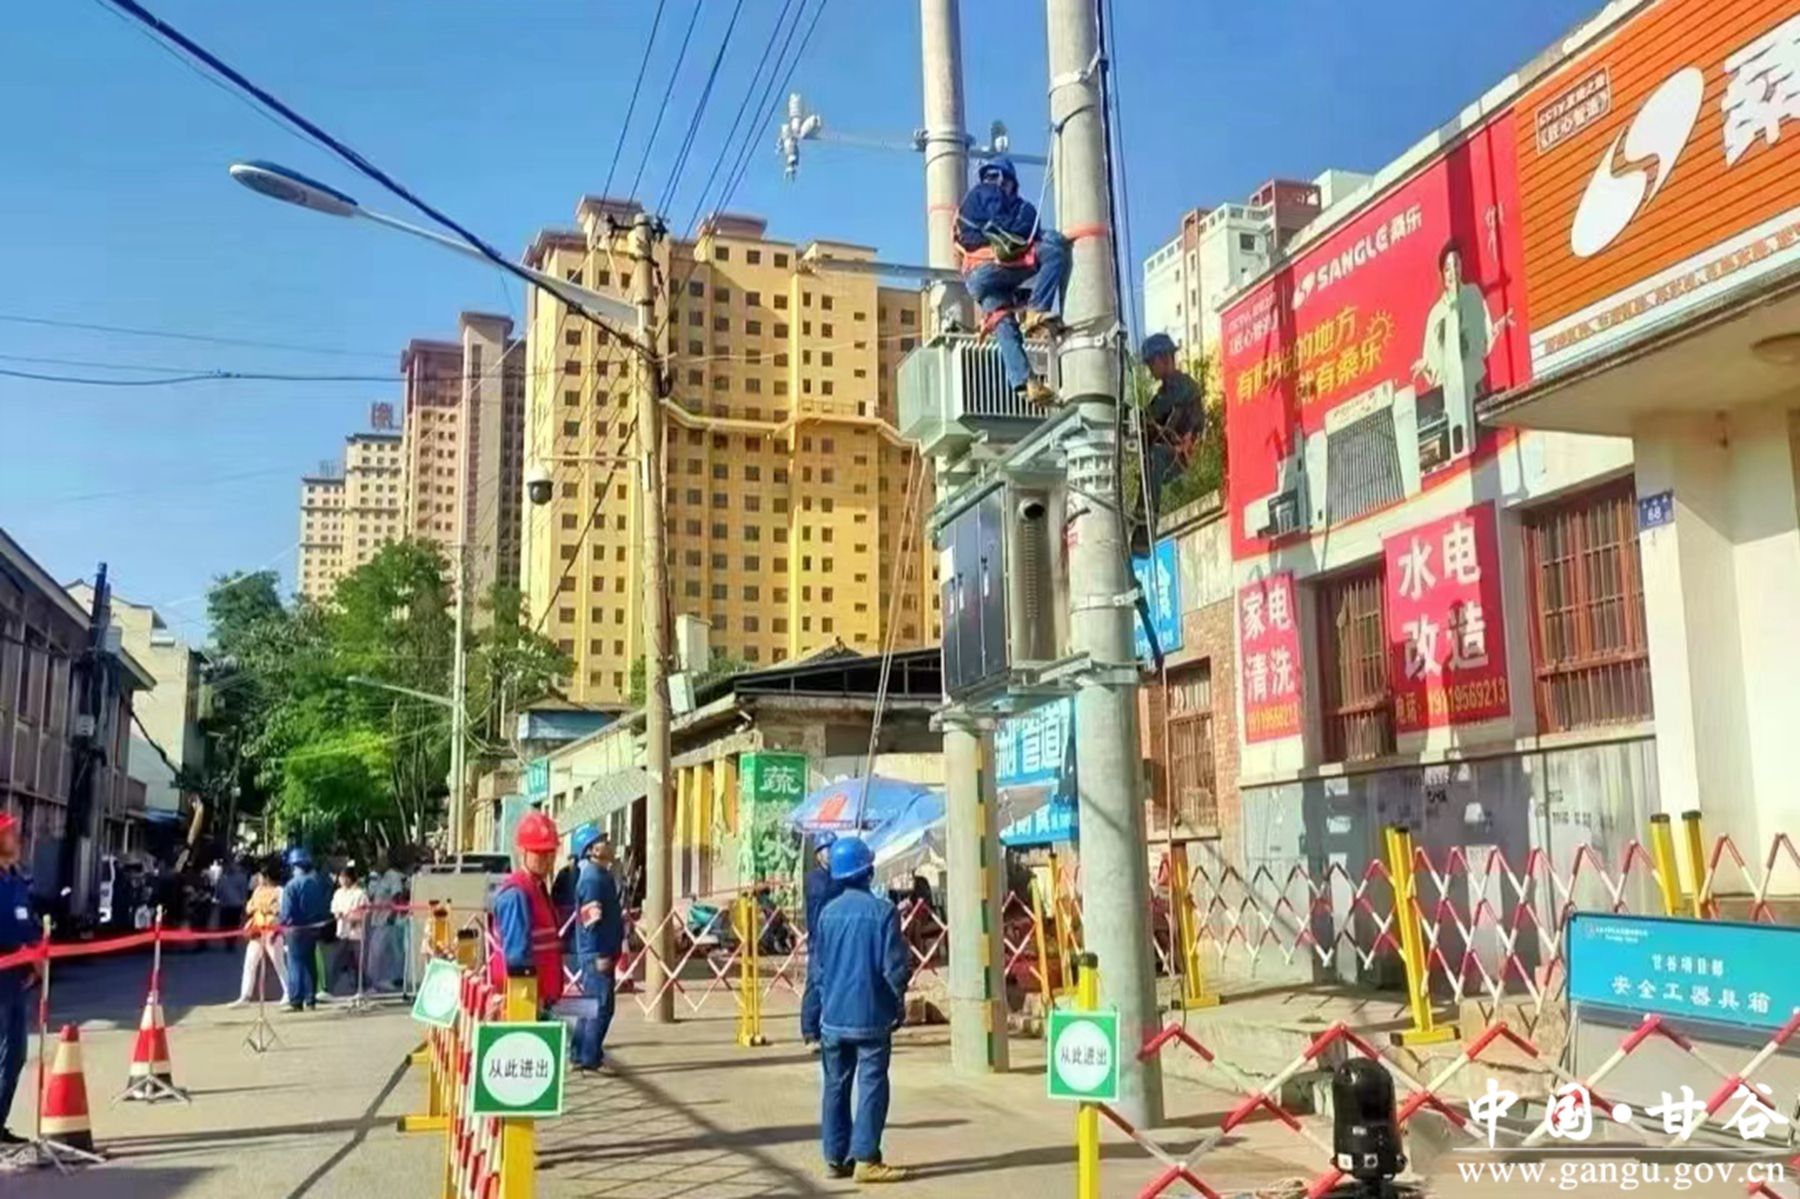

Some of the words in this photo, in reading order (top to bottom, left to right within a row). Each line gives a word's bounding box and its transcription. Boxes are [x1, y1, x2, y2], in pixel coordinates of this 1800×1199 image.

[1316, 223, 1389, 292] SANGLE
[1397, 517, 1482, 601] 水电
[1242, 583, 1292, 641] 家电
[1402, 600, 1490, 682] 改造
[1245, 644, 1295, 703] 清洗
[1611, 974, 1772, 1014] 安全工器具箱
[1651, 953, 1724, 977] 甘谷项目部
[488, 1058, 549, 1079] 从此进出
[1060, 1045, 1107, 1066] 从此进出
